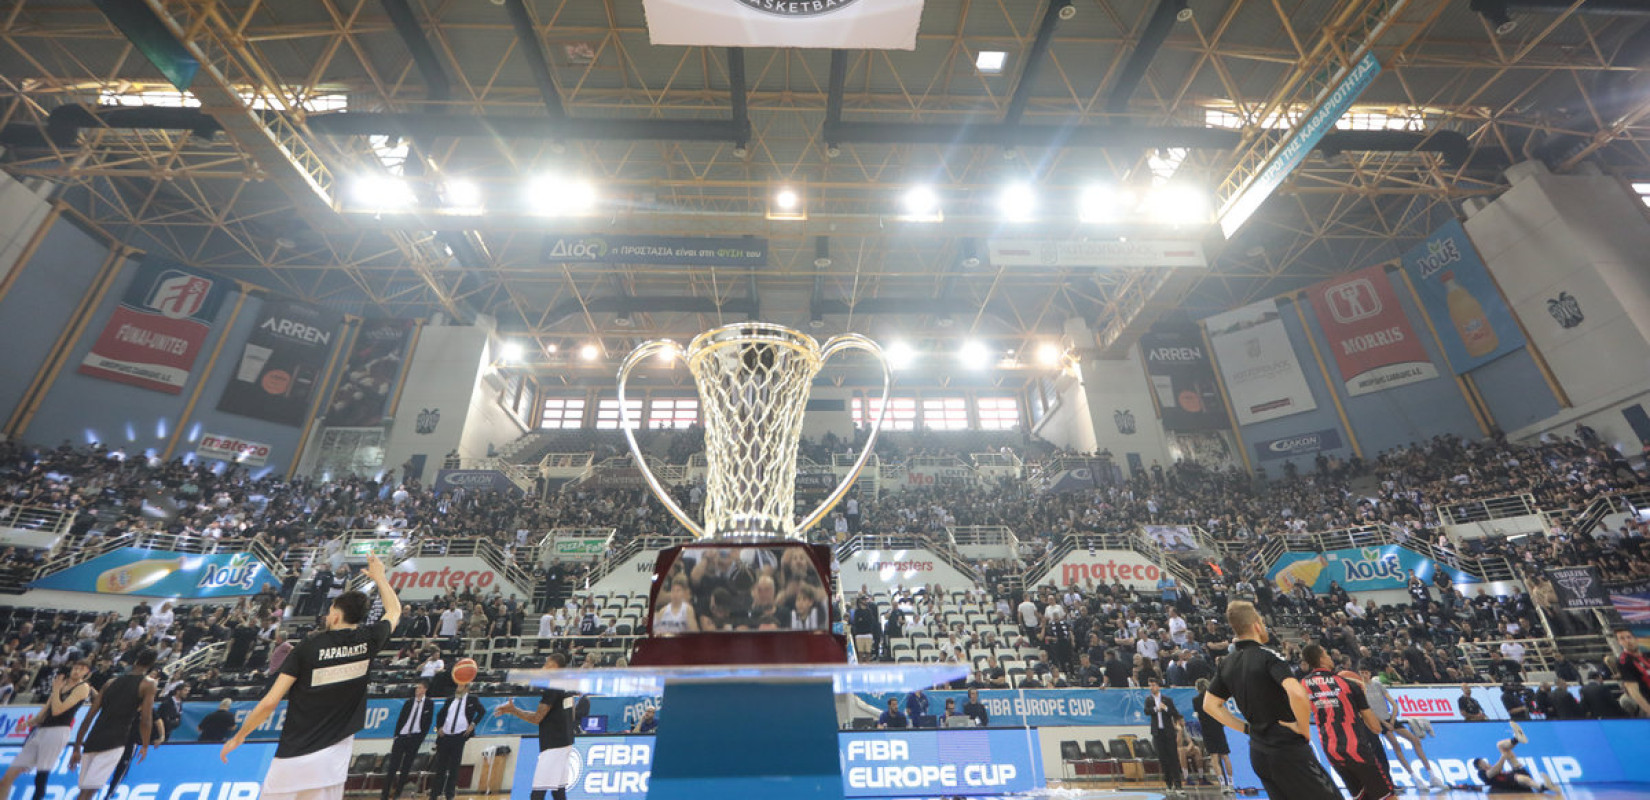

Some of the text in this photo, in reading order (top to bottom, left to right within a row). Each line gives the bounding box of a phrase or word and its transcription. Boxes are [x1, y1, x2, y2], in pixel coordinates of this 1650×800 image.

[1299, 55, 1375, 143] ΚΑΘΑΡΙΟΤΗΤΑΣ
[621, 246, 672, 256] ΠΡΟΣΤΑΣΙΑ
[717, 249, 742, 258] ΦΥΣΗ
[261, 317, 331, 345] ARREN
[1341, 327, 1405, 355] MORRIS
[1149, 347, 1202, 361] ARREN
[202, 436, 268, 457] mateco
[857, 559, 934, 573] winmasters
[1062, 559, 1160, 587] mateco
[388, 565, 495, 589] mateco
[318, 642, 368, 661] PAPADAKIS
[981, 697, 1096, 717] FIBA EUROPE CUP
[1397, 694, 1453, 712] therm
[363, 708, 390, 729] UP
[586, 744, 651, 767] FIBA
[847, 739, 910, 761] FIBA
[849, 763, 1017, 788] EUROPE CUP
